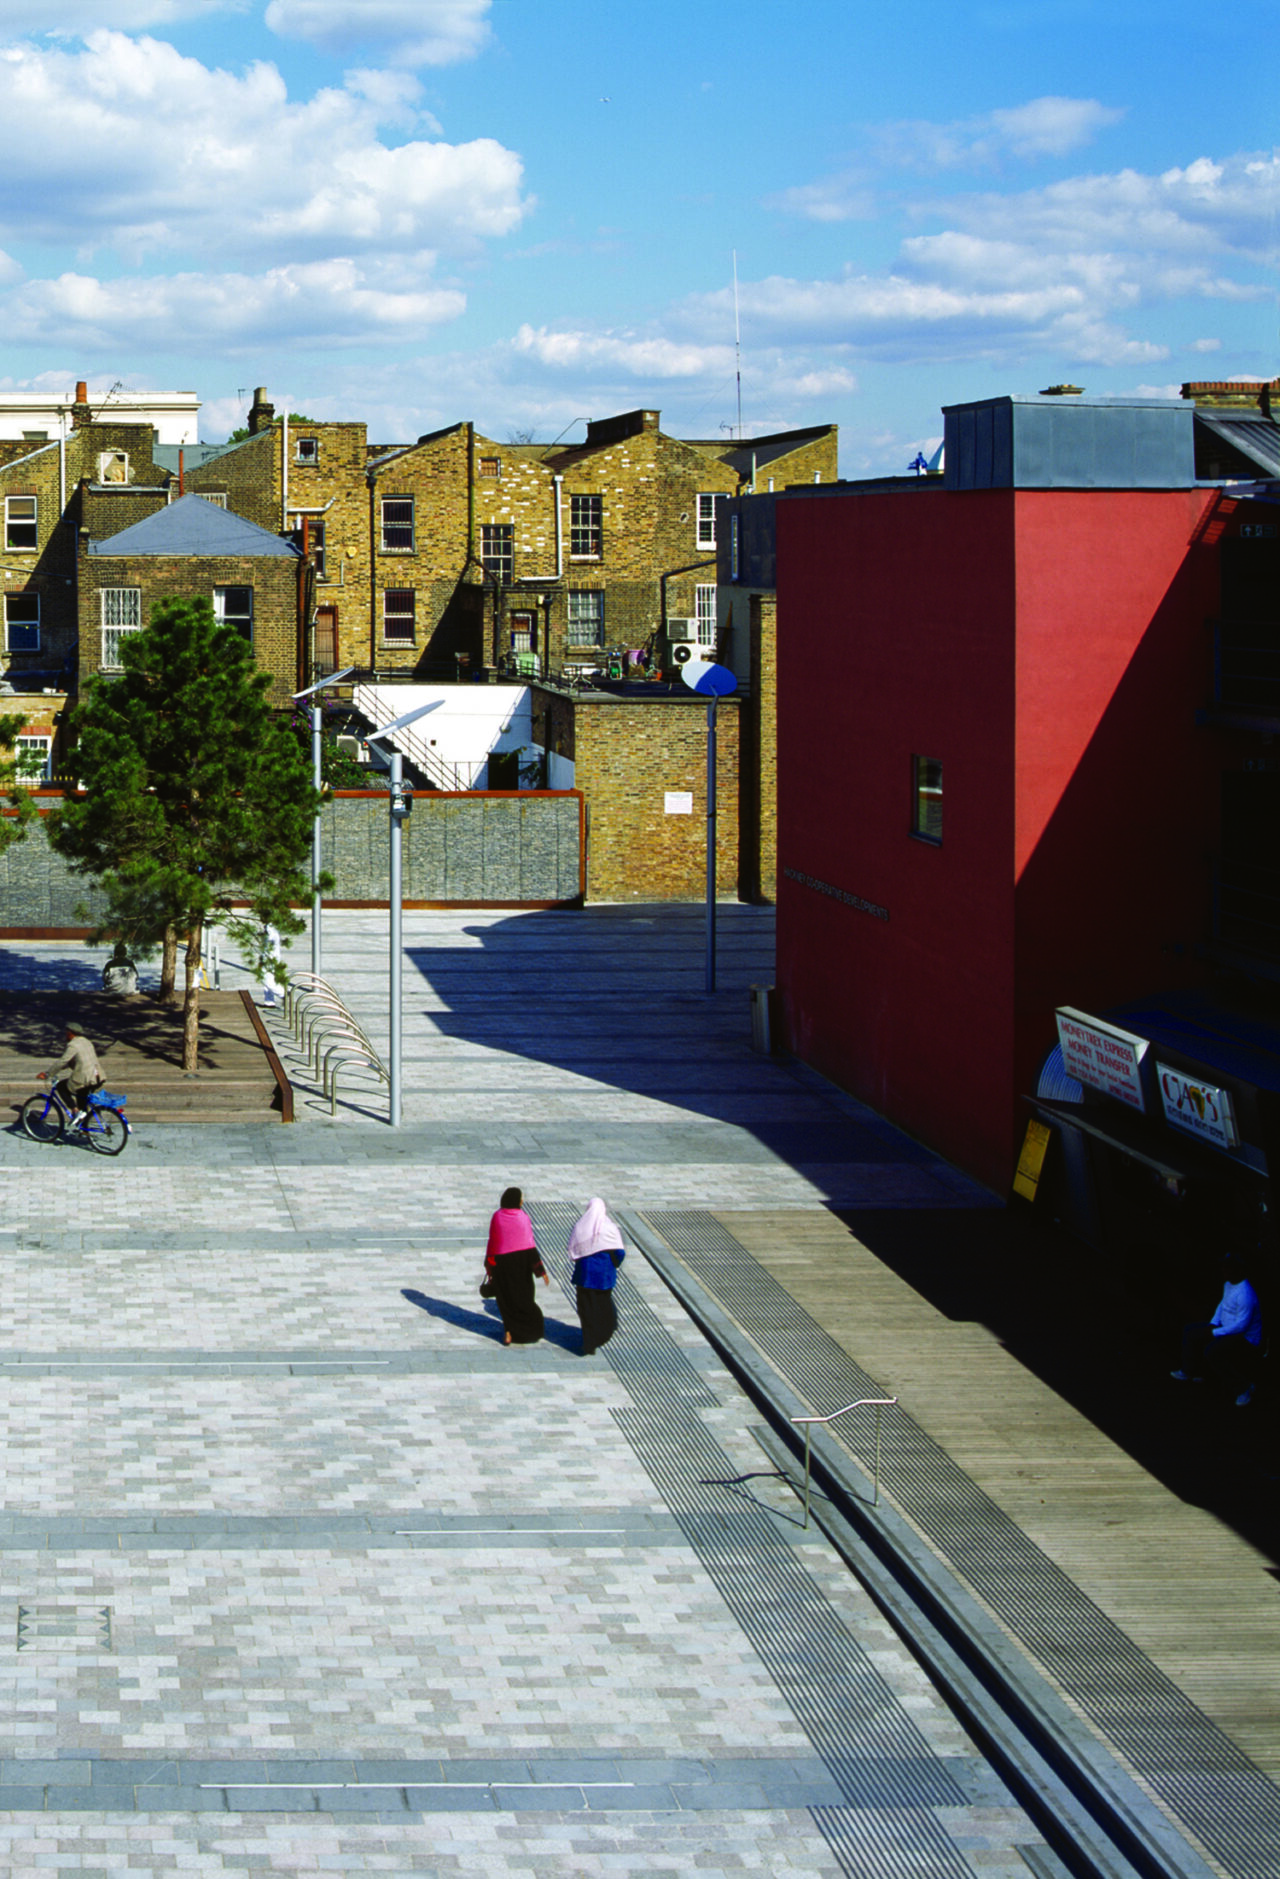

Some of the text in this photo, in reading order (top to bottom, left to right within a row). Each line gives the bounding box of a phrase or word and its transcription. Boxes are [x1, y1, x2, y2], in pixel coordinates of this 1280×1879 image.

[843, 891, 889, 922] DEVELOPMENTS
[1067, 1038, 1092, 1058] MONEY
[1095, 1050, 1131, 1076] TRANSFER
[1104, 1039, 1133, 1063] EXPRESS
